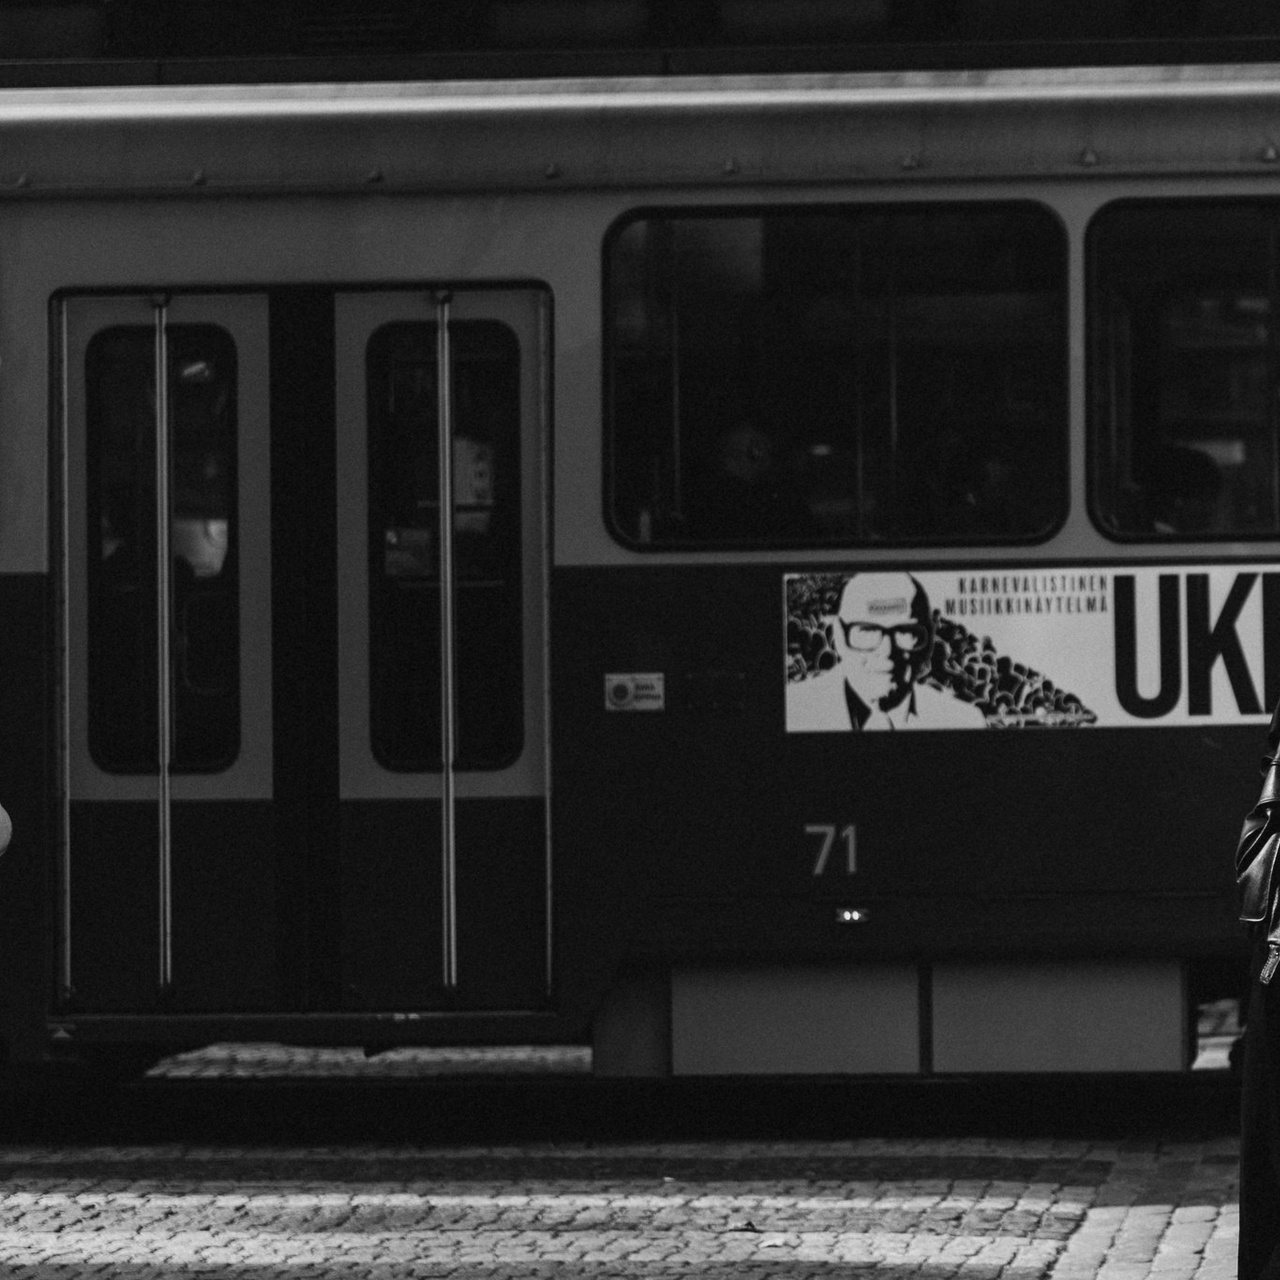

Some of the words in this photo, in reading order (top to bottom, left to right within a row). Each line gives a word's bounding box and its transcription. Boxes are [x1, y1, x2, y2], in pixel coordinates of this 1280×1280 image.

[959, 575, 1108, 594] KARNEVALISTINEN
[945, 595, 1108, 615] MUSIIKKINÄYTELMÄ
[804, 824, 857, 876] 71
